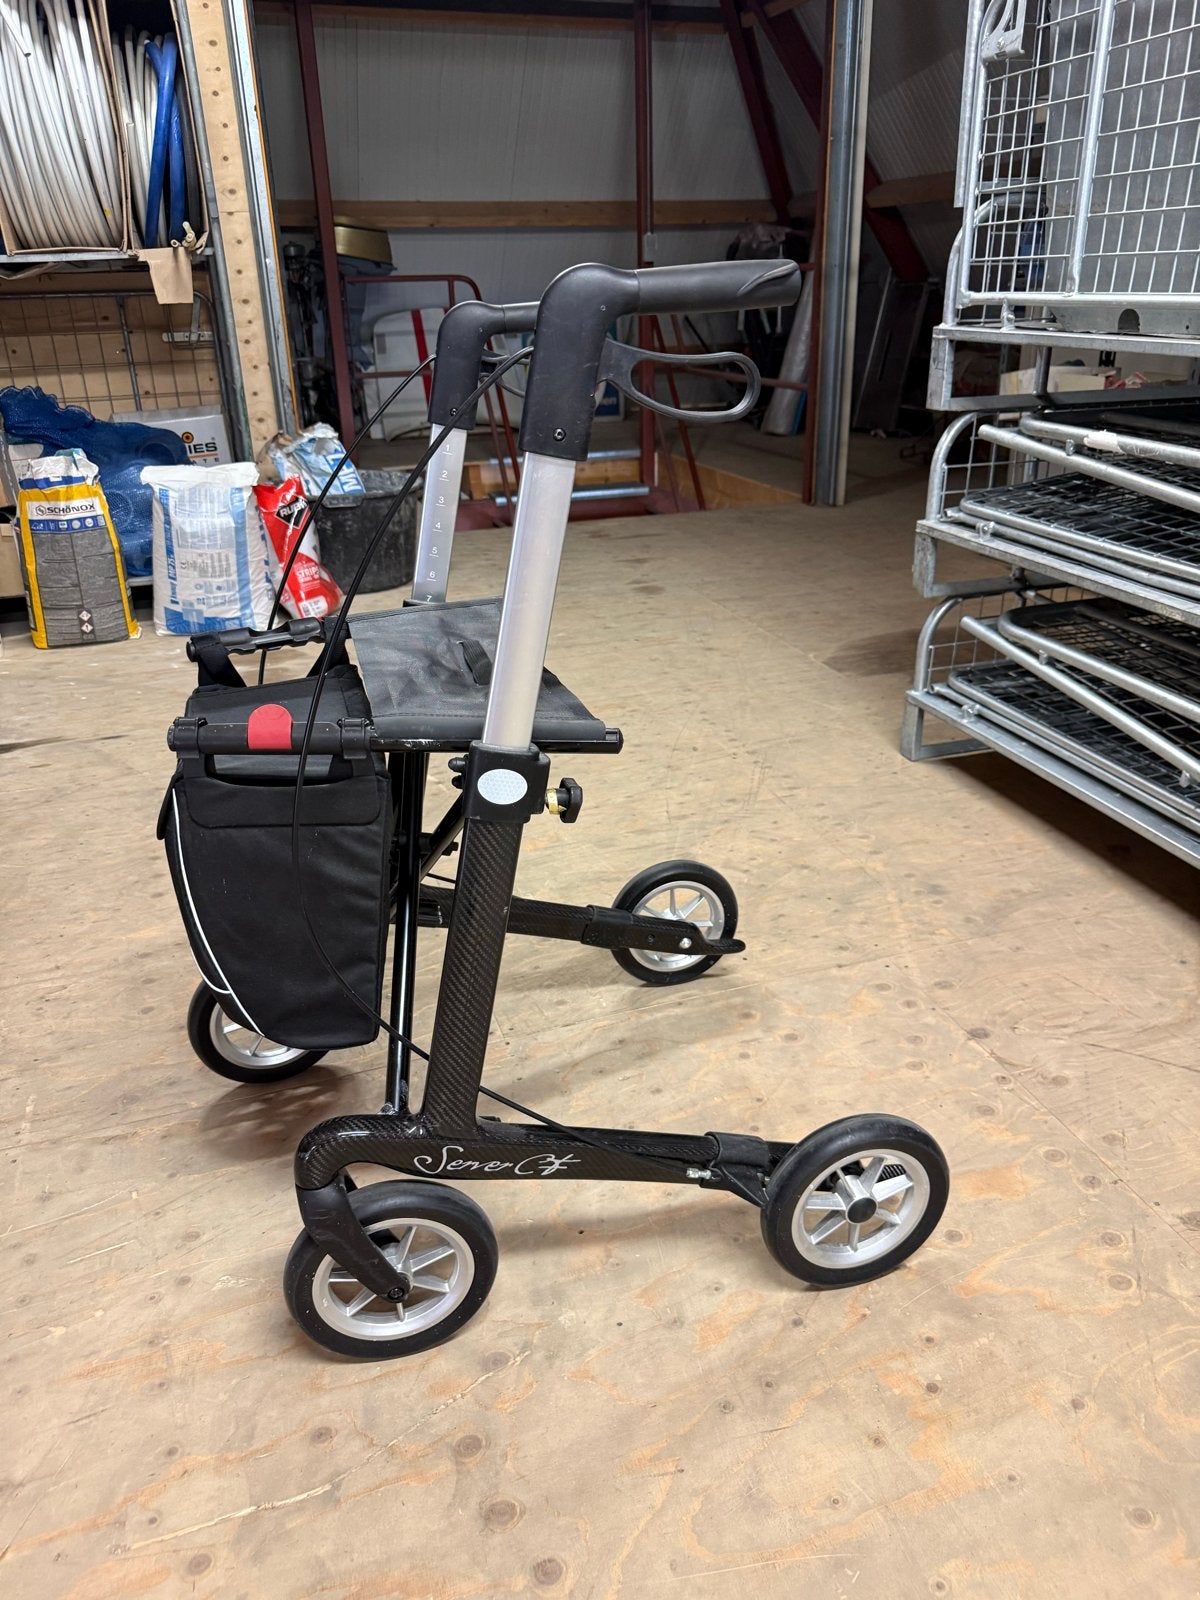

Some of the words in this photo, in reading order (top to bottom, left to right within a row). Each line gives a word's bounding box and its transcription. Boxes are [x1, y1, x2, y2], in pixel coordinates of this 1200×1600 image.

[187, 442, 218, 455] IES
[441, 470, 448, 478] 2
[438, 496, 445, 504] 3
[46, 503, 96, 514] SCHÖNOX
[431, 546, 438, 554] 5
[429, 570, 436, 578] 6
